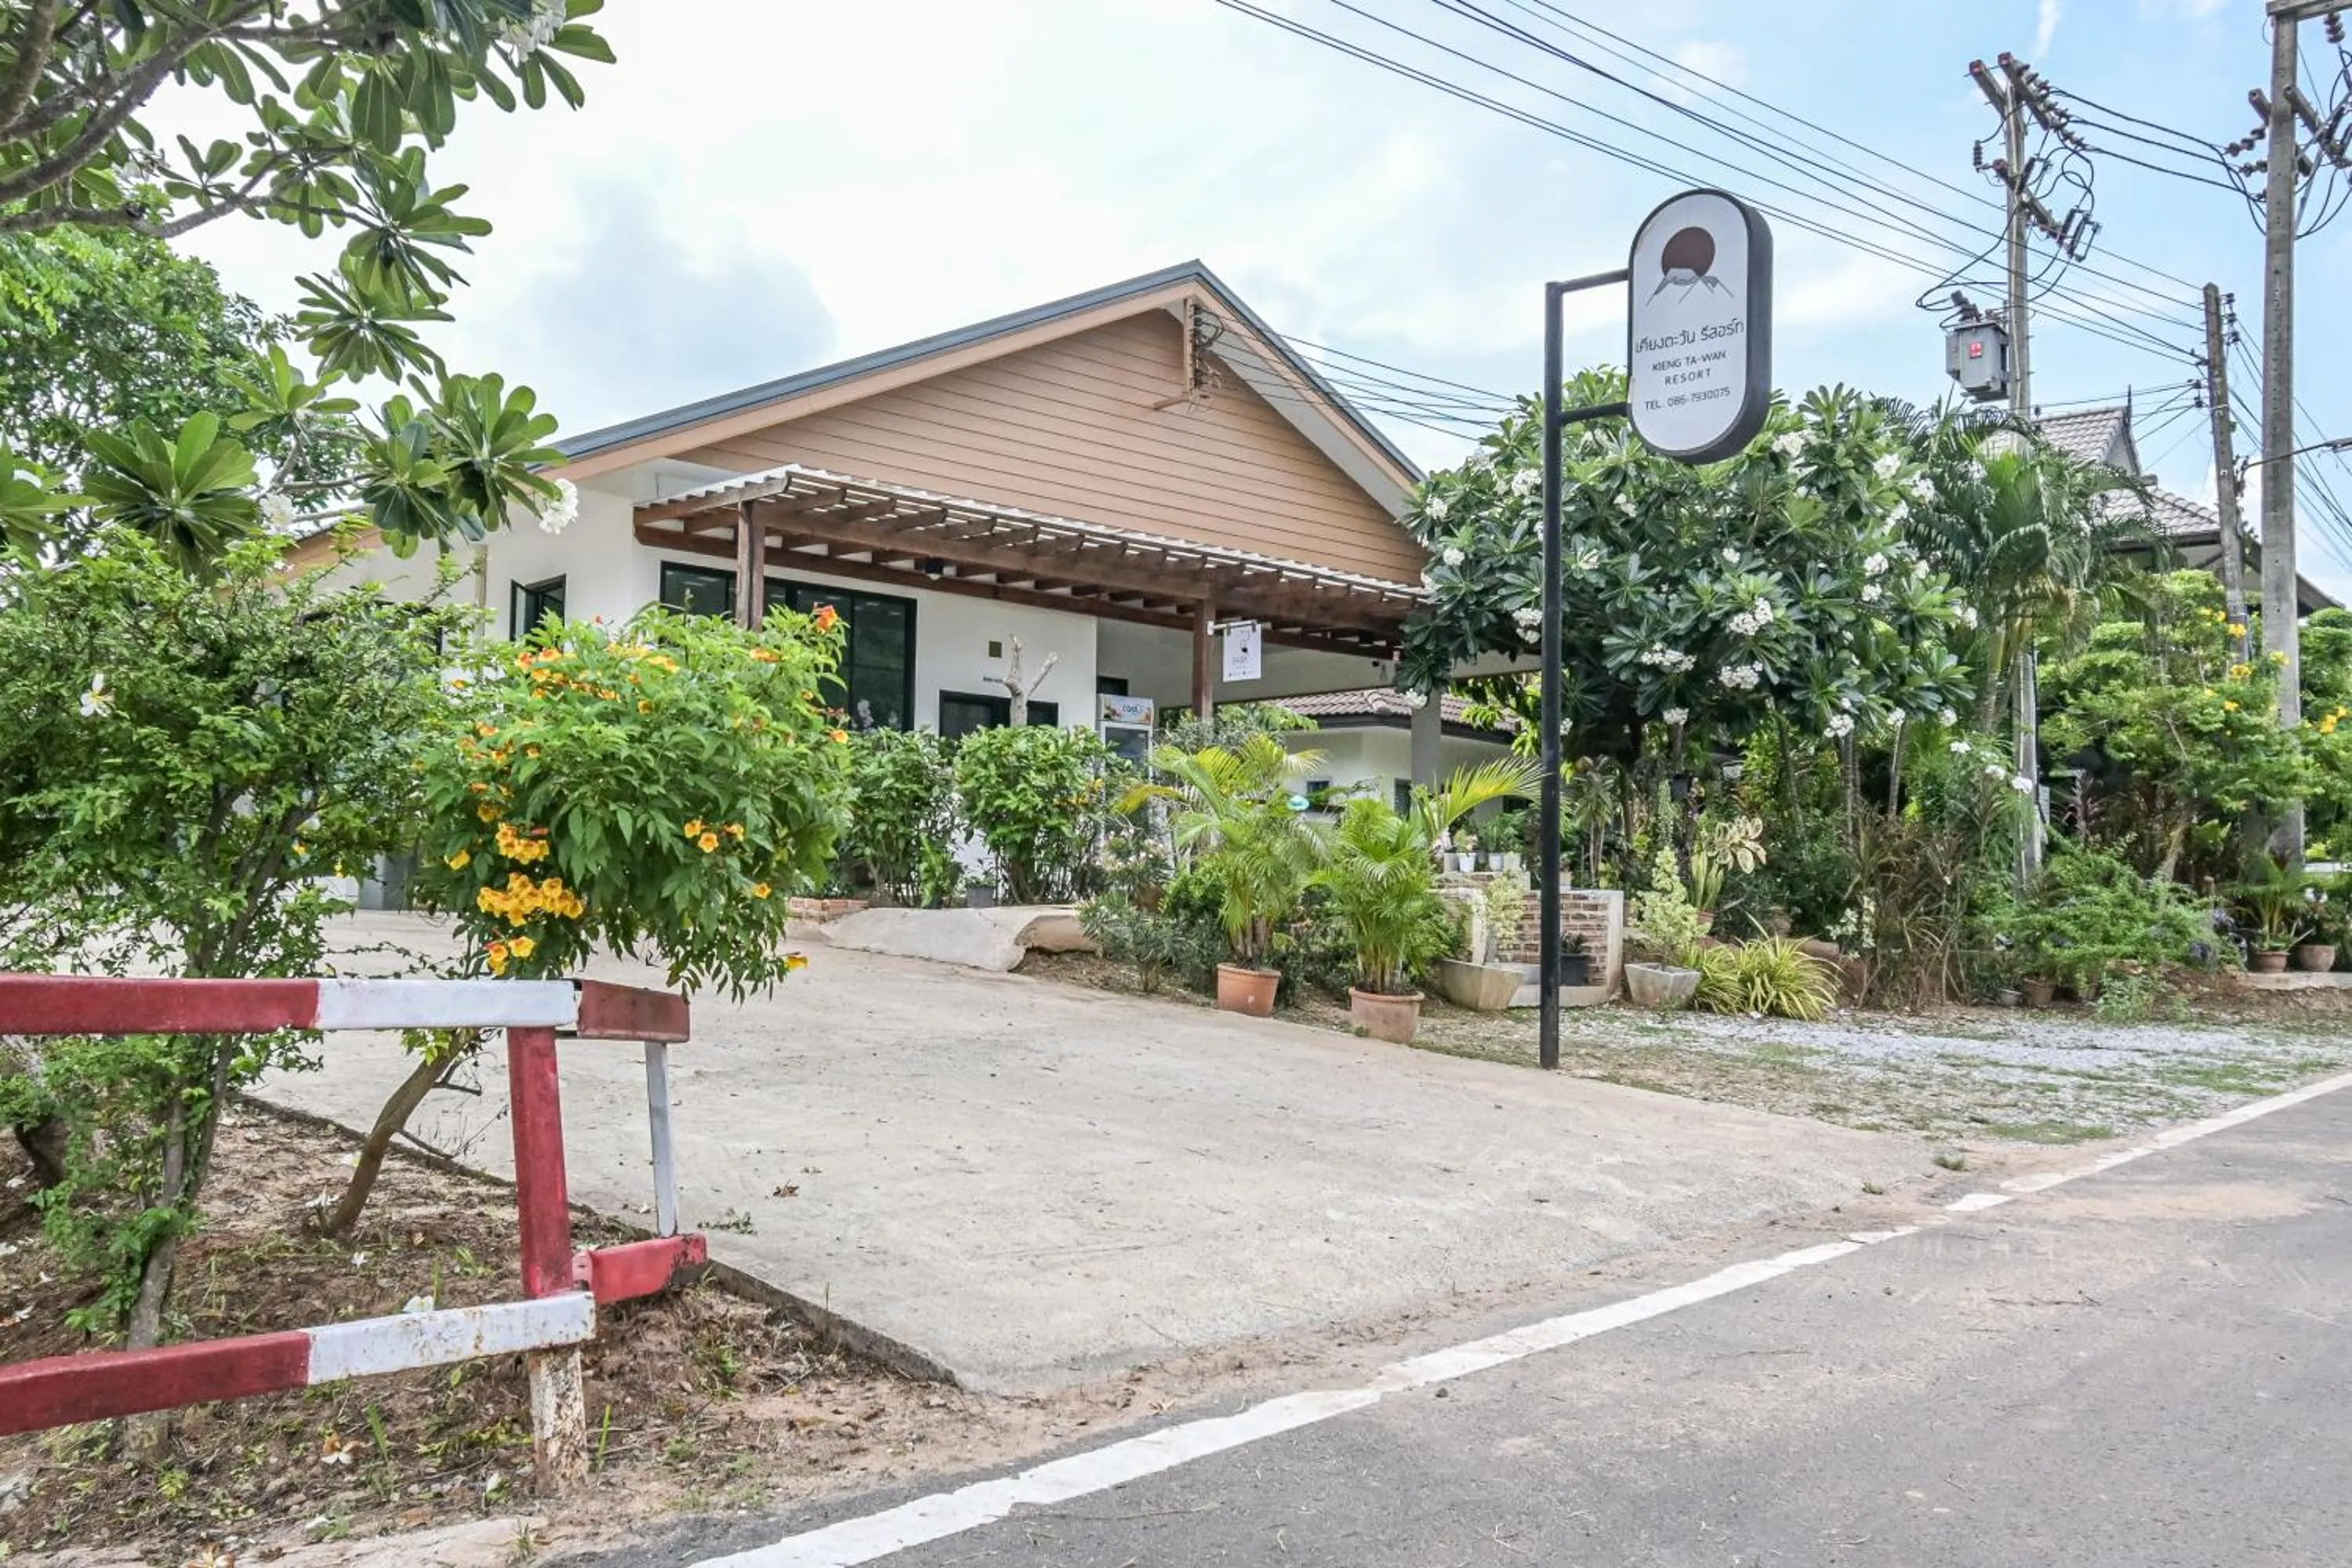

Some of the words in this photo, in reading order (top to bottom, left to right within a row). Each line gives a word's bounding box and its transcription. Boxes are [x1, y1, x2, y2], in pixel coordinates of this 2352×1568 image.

[1652, 359, 1682, 372] KIENG
[1686, 351, 1726, 365] TA-WAN
[1664, 368, 1711, 385] RESORT
